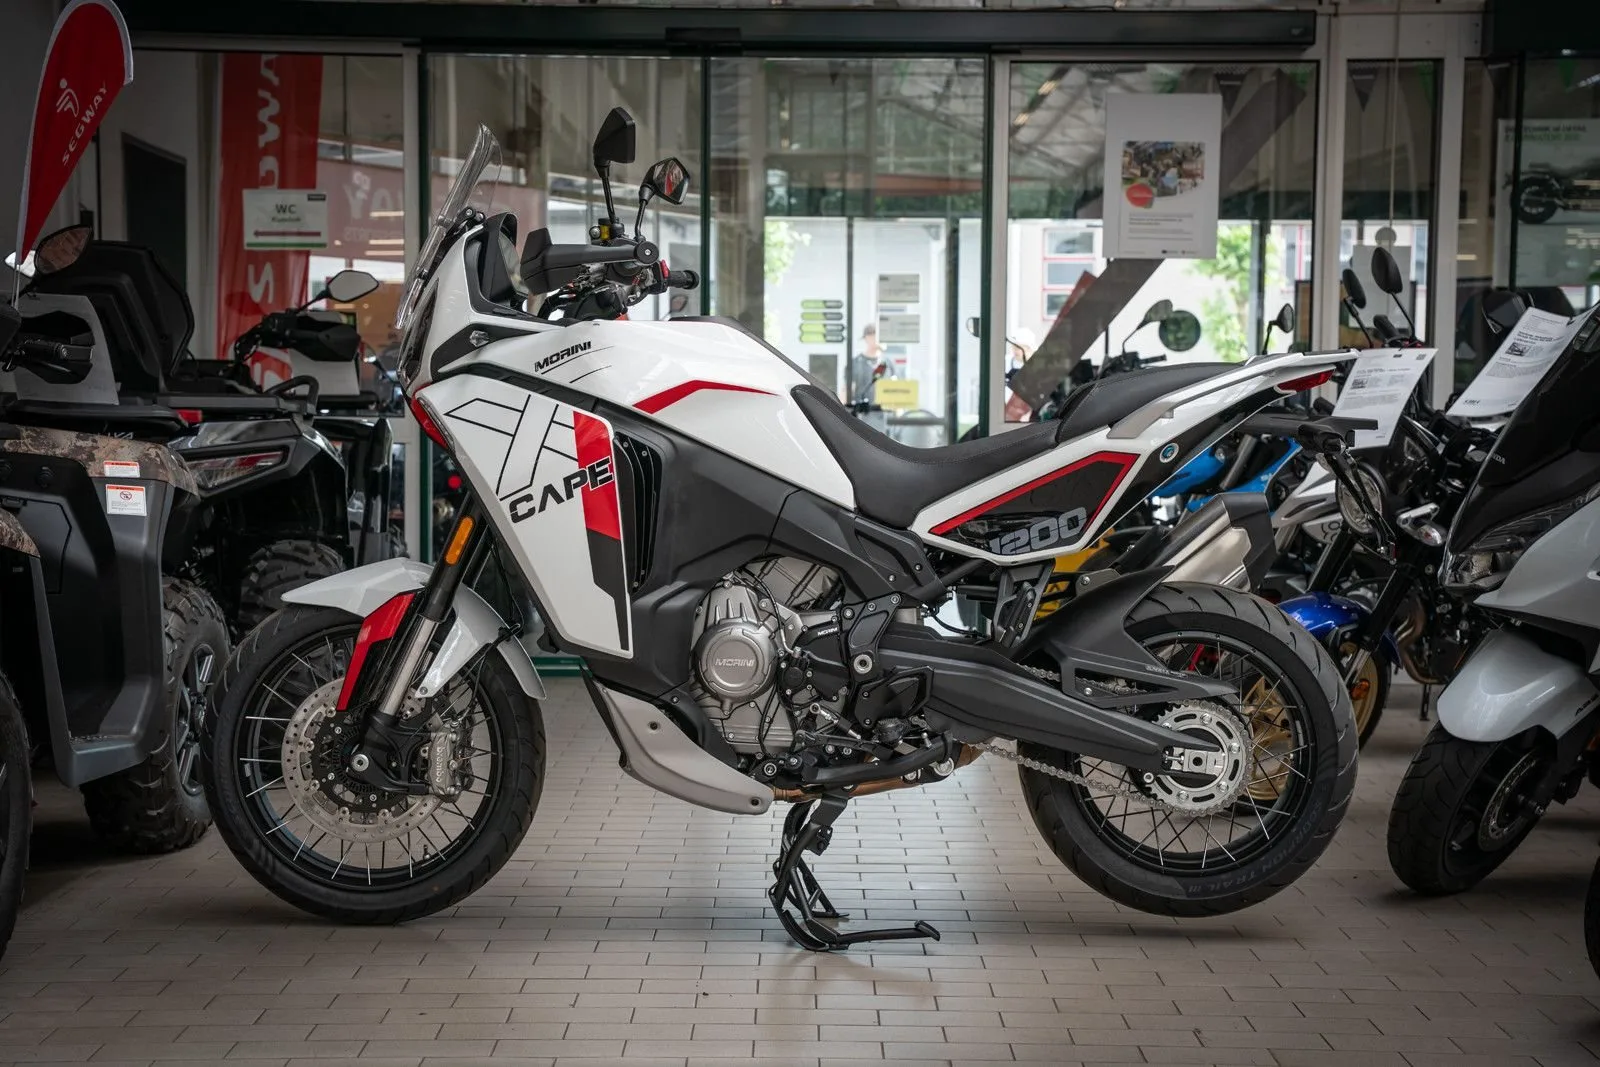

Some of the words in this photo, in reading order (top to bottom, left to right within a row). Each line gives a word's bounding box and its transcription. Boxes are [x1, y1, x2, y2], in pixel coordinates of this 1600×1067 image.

[62, 80, 107, 166] SEGWAY
[275, 204, 297, 214] WC
[534, 341, 592, 372] MORINI
[509, 457, 614, 523] CAPE
[989, 506, 1087, 555] 1200
[817, 627, 838, 636] MORINI
[714, 658, 755, 667] MORINI
[435, 747, 446, 783] brembo
[1262, 801, 1323, 872] SCORPION
[1209, 870, 1256, 891] TRAIL
